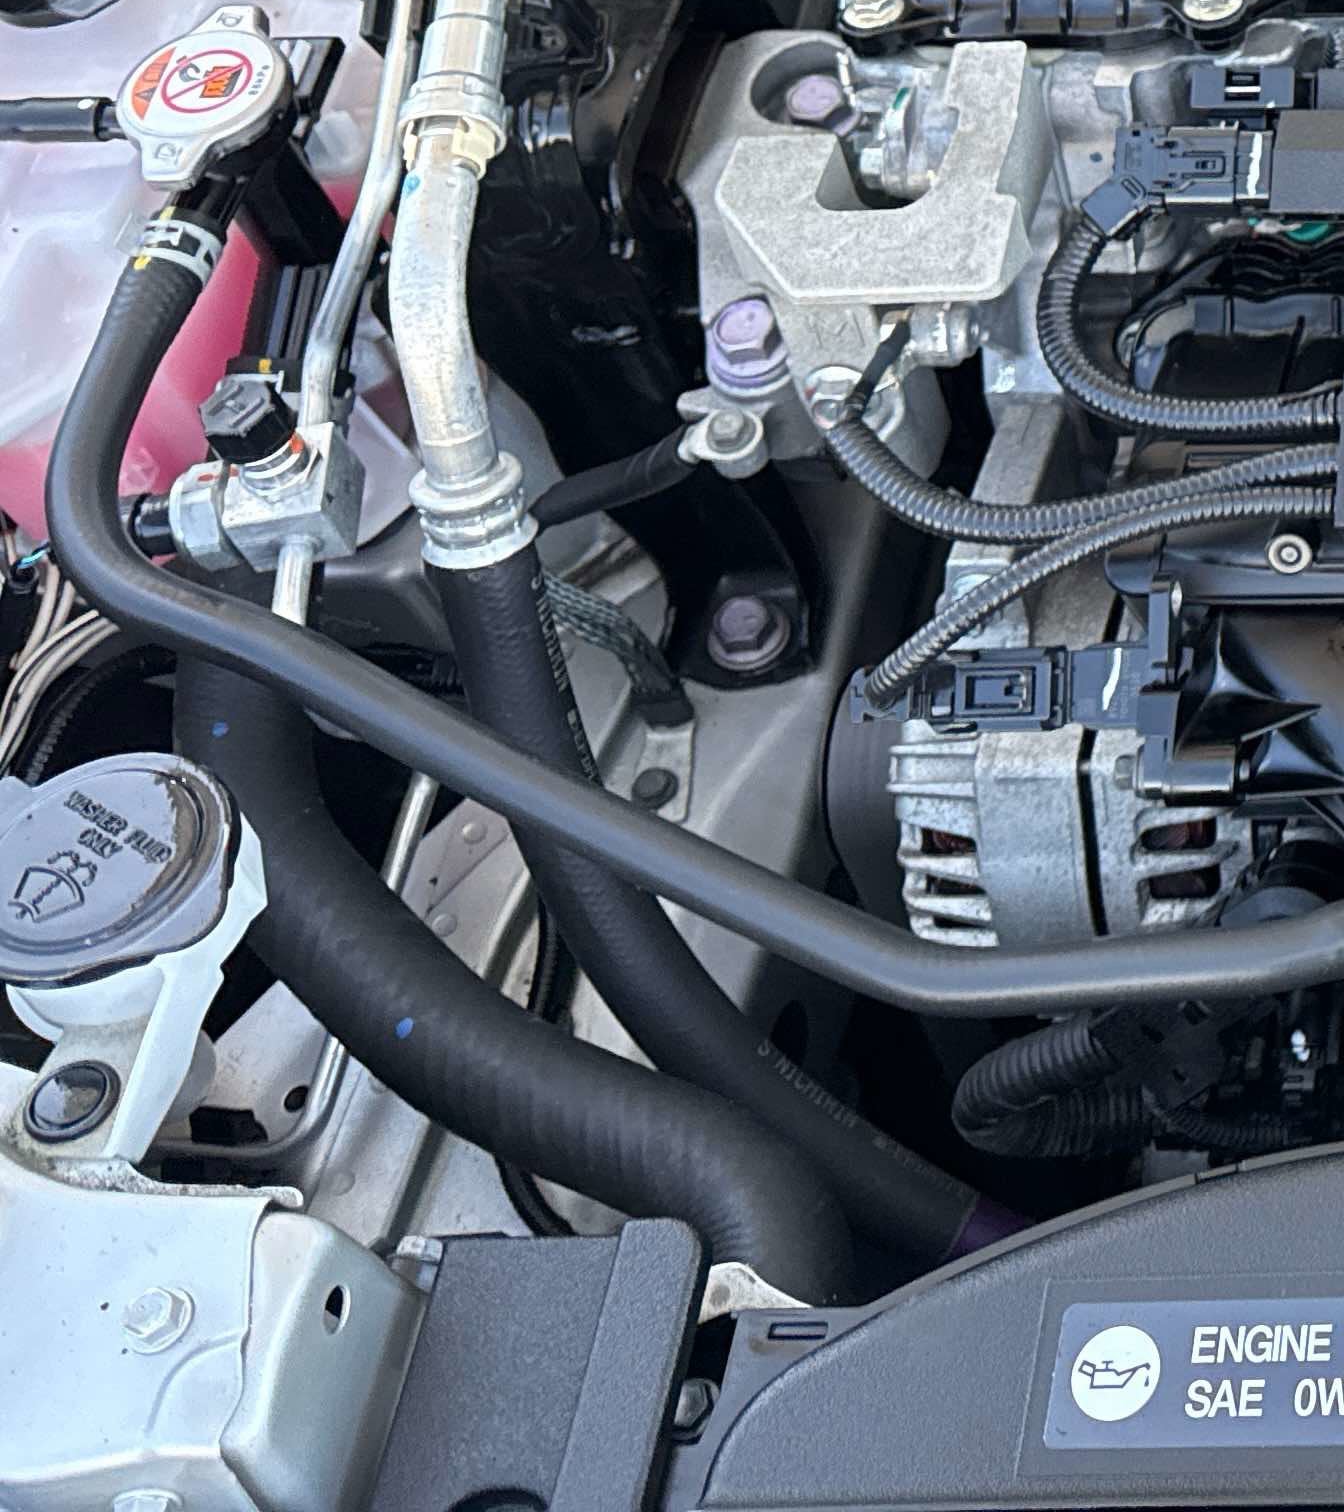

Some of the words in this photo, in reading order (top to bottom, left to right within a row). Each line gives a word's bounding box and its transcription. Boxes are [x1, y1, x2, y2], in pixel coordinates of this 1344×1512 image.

[64, 790, 128, 836] WASHER
[124, 829, 172, 863] FLUID
[78, 828, 123, 859] ONLY
[1191, 1323, 1333, 1364] ENGINE
[1184, 1378, 1266, 1419] SAE
